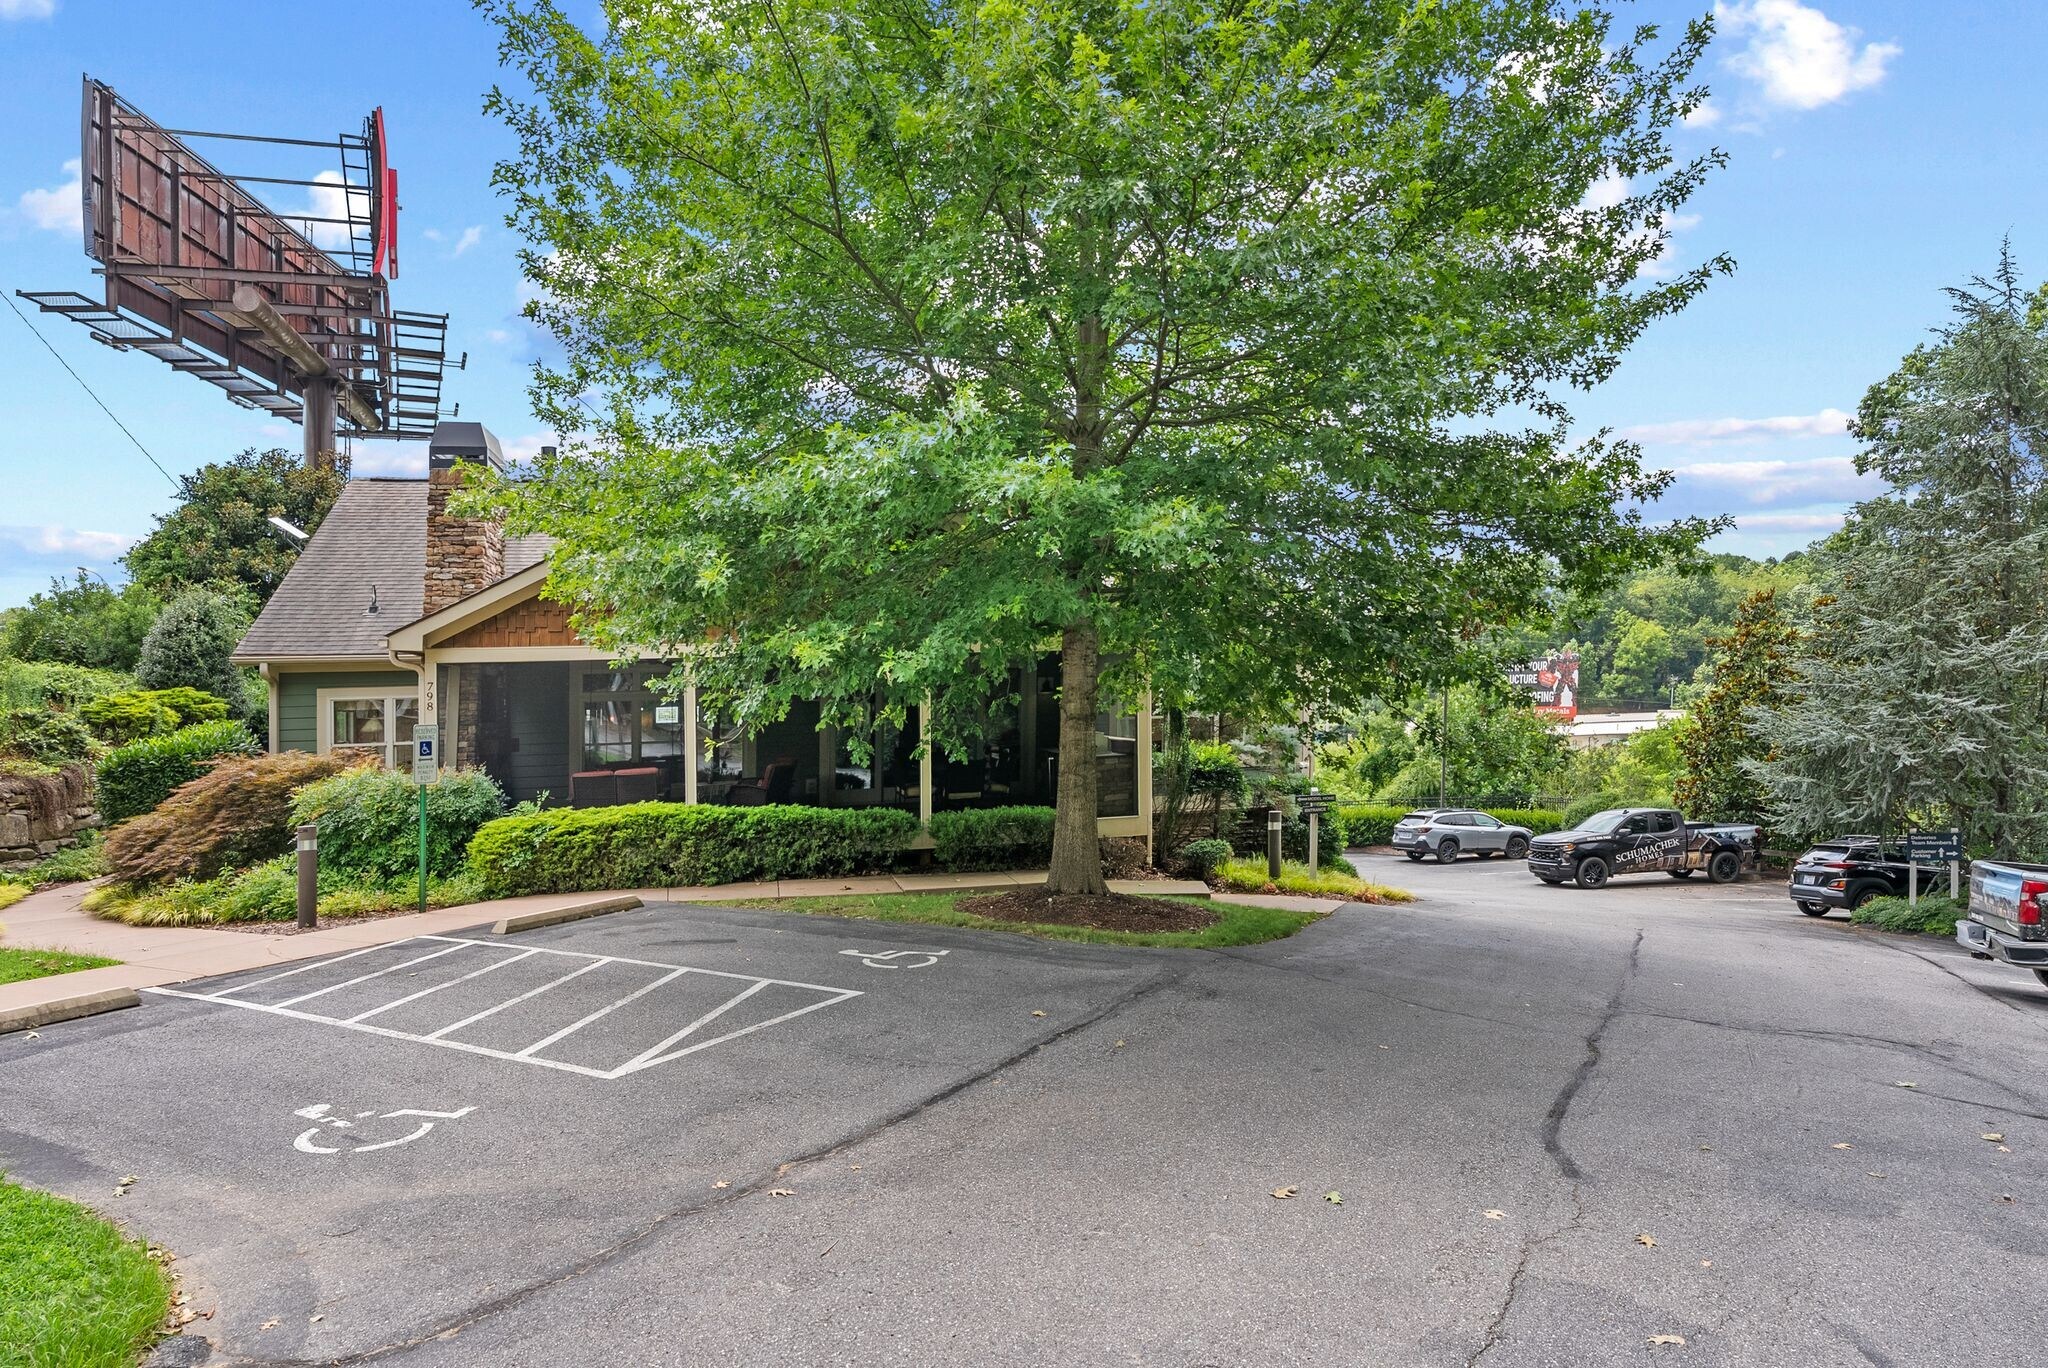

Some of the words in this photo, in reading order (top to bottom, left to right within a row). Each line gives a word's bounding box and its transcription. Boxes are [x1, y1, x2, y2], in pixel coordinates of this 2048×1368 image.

[1509, 673, 1538, 684] UCTURE
[426, 682, 434, 711] 798
[1615, 838, 1680, 863] SCHUMACHER
[1635, 851, 1664, 864] HOMES
